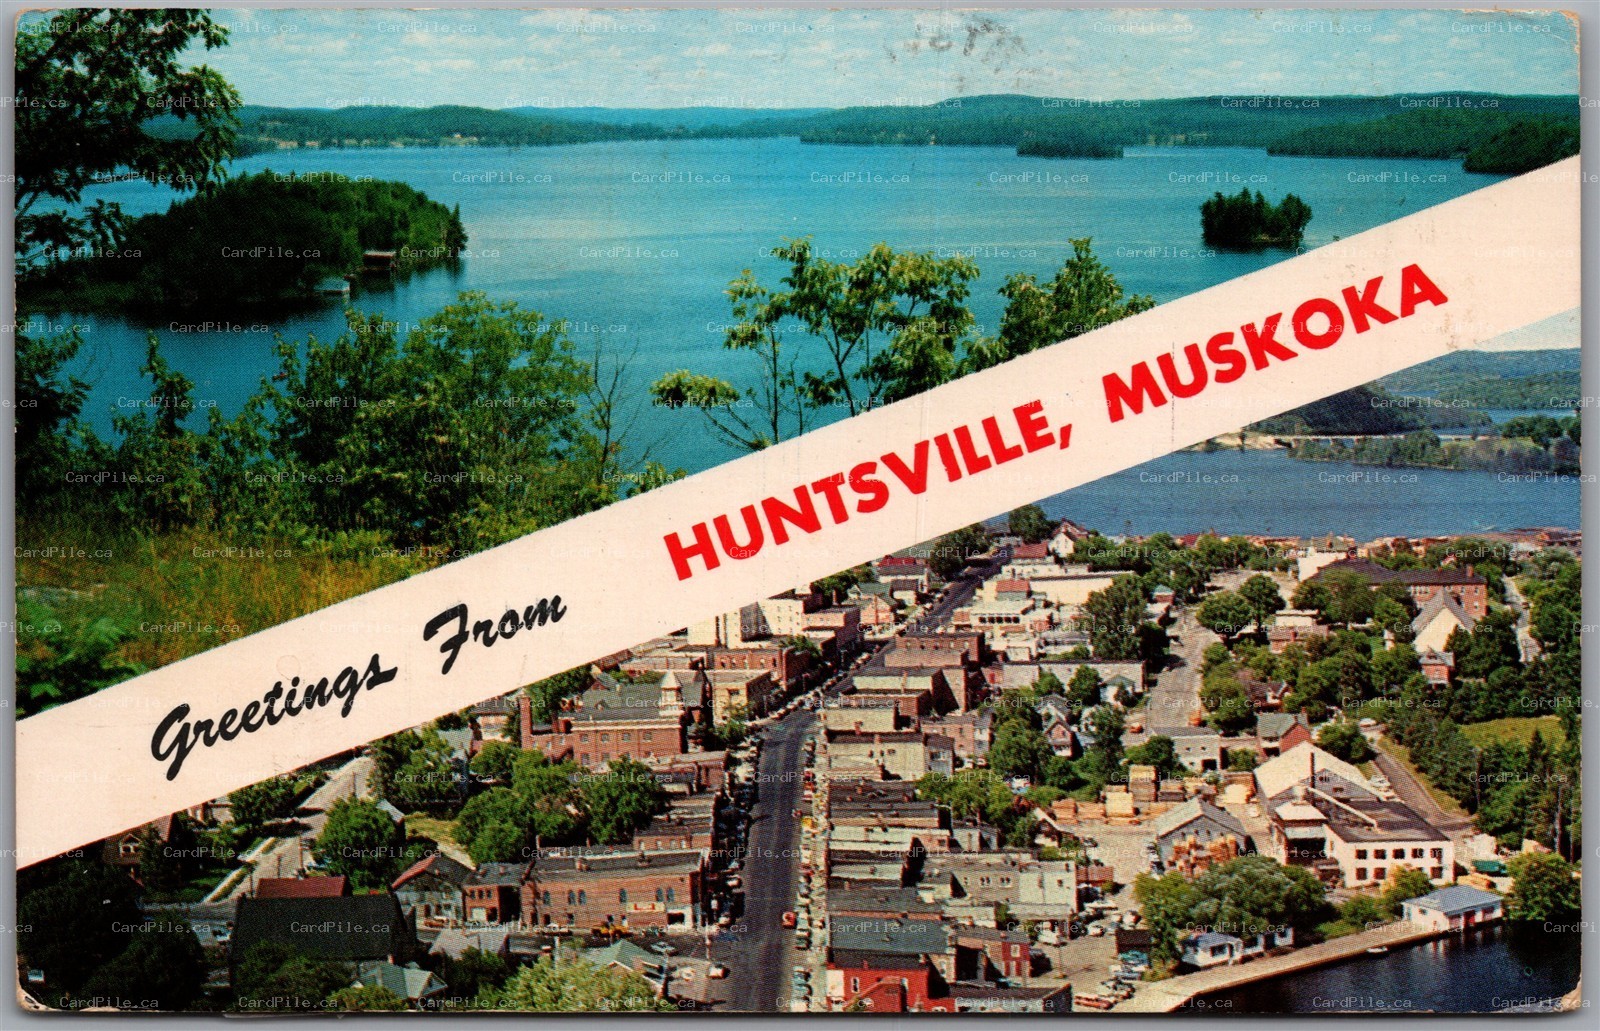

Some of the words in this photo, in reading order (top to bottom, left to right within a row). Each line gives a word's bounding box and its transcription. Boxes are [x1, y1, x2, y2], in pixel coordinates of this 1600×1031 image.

[664, 400, 1072, 581] HUNTSVILLE,
[1102, 263, 1448, 423] MUSKOKA
[151, 653, 398, 781] Greetings
[423, 594, 567, 675] From
